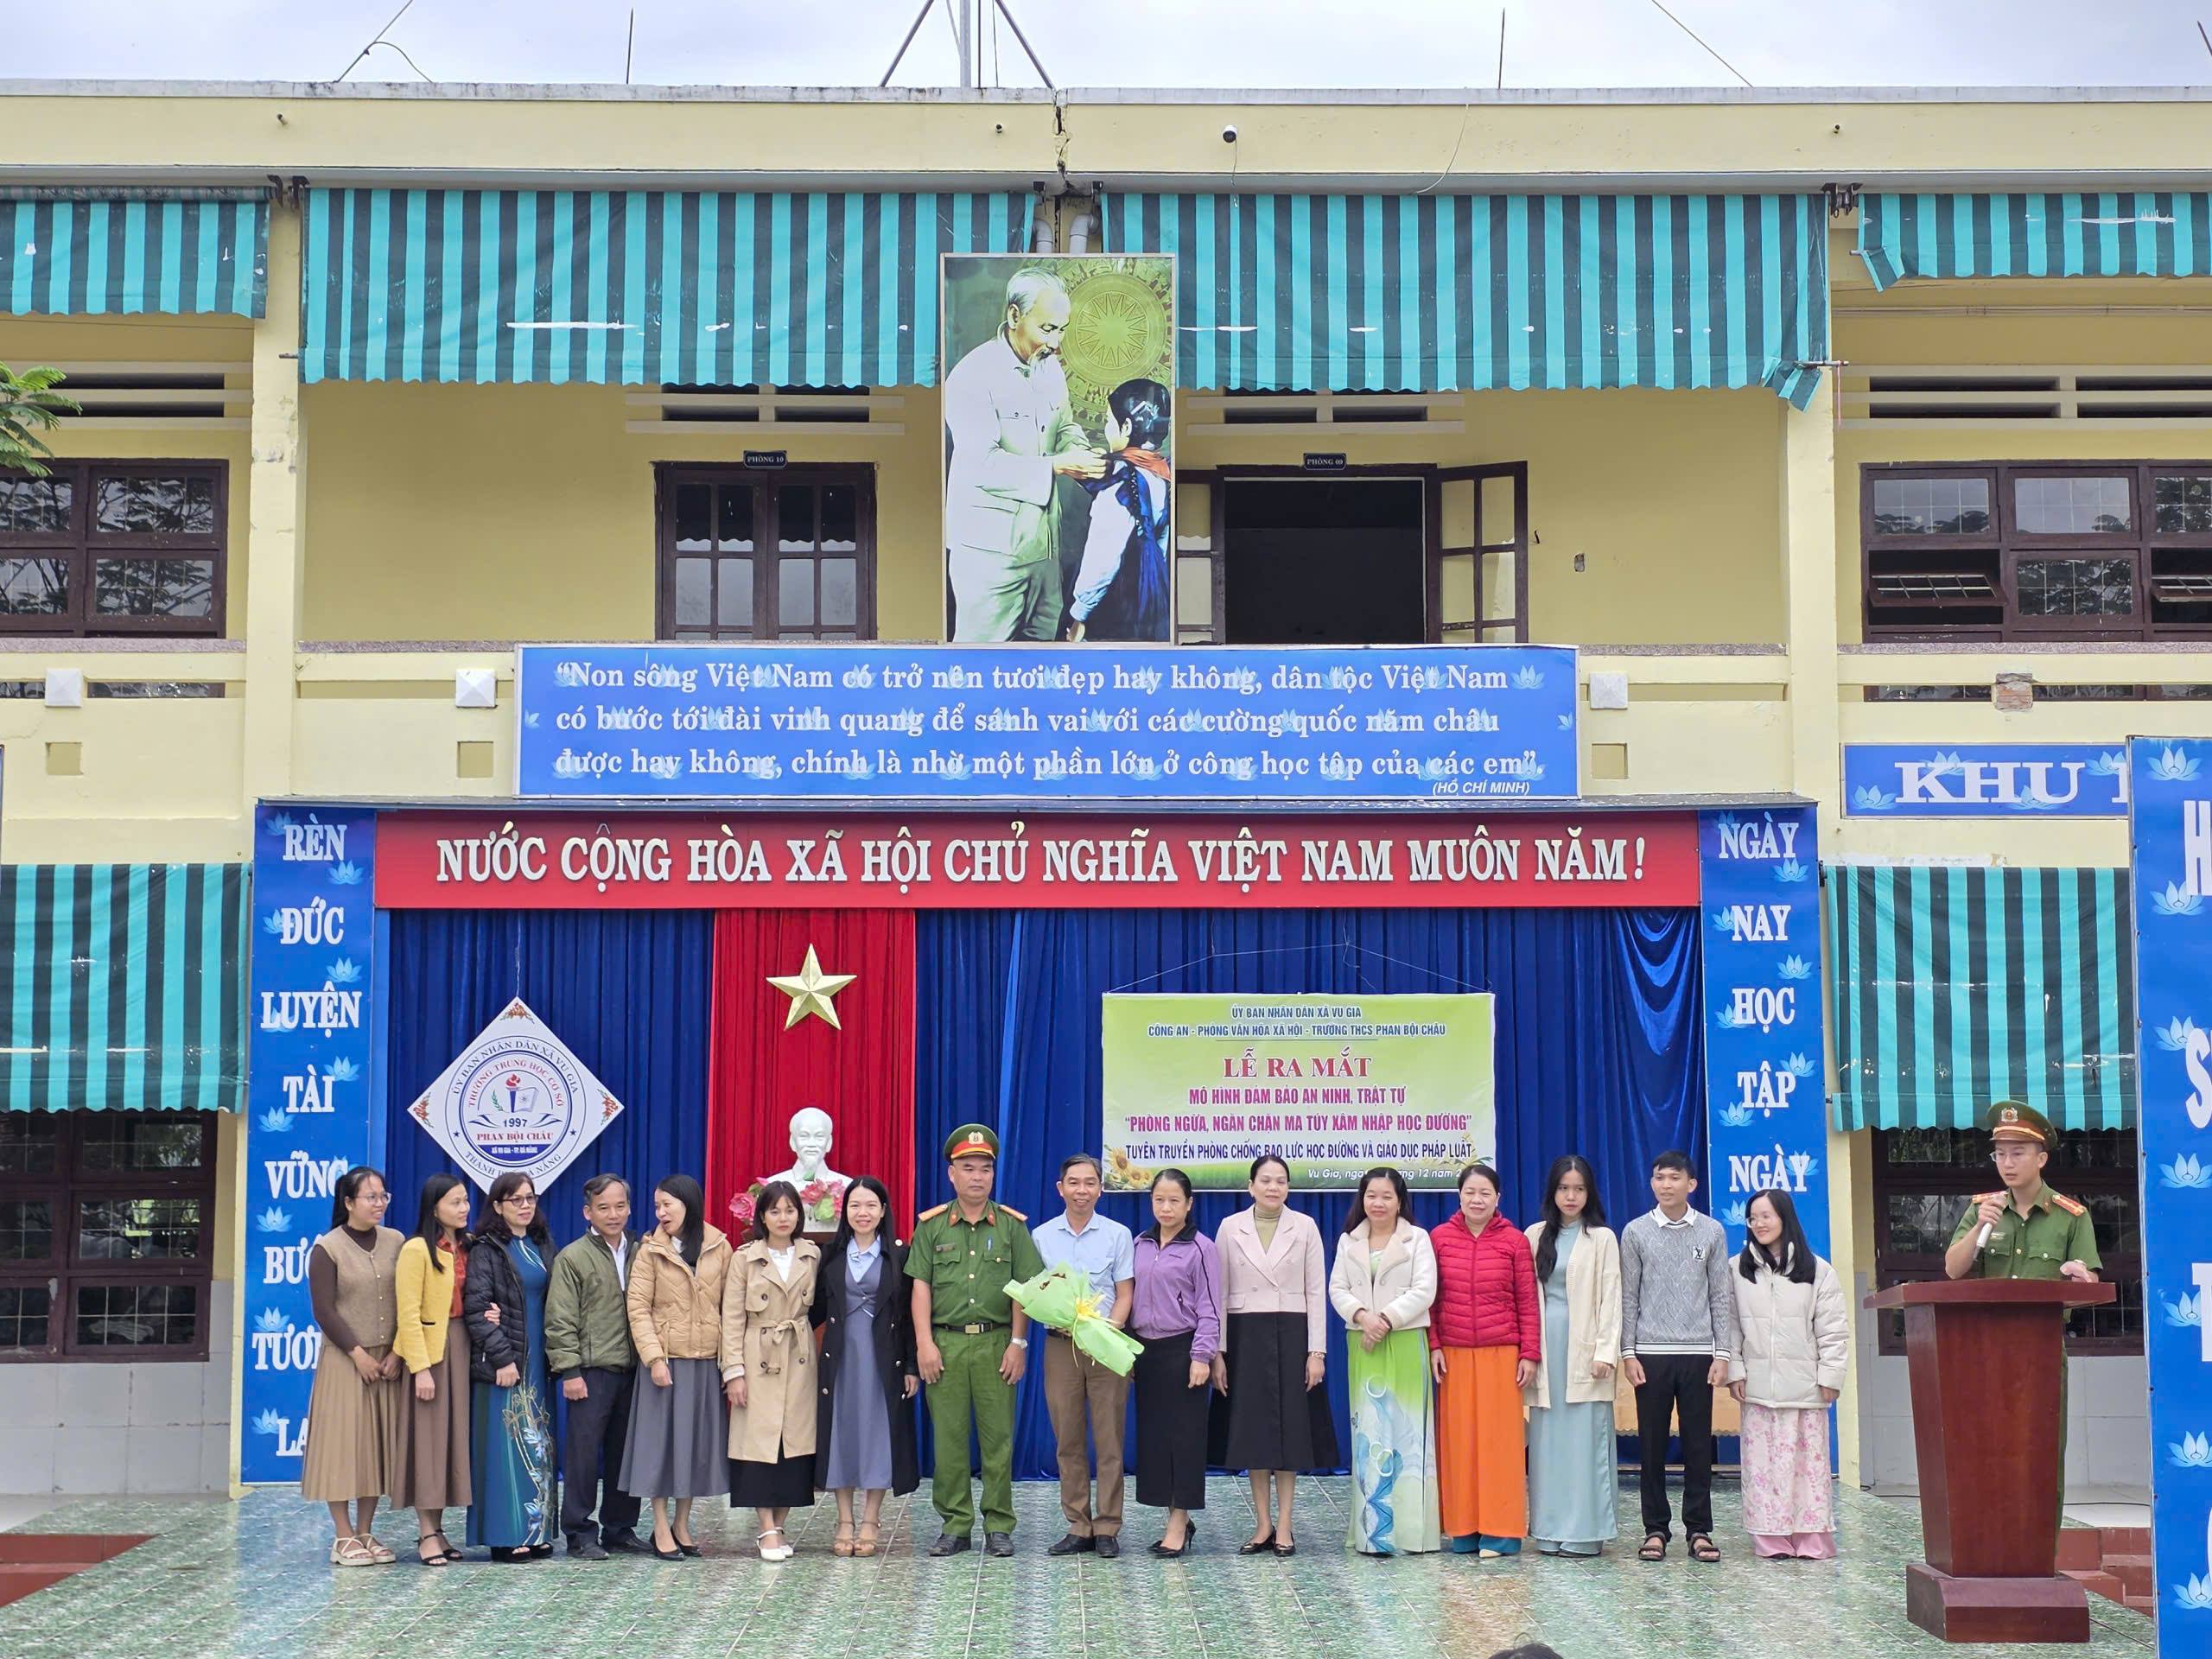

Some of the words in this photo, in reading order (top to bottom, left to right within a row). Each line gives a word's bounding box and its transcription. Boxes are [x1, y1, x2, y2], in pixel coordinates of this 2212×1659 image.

[747, 454, 774, 463] PHÒNG
[1306, 456, 1334, 466] PHÒNG
[633, 664, 697, 692] sông
[706, 663, 763, 688] Việt
[772, 664, 832, 688] Nam
[842, 663, 872, 689] có
[882, 663, 923, 689] trở
[932, 664, 983, 689] nên
[992, 664, 1046, 690] tươi
[1055, 664, 1103, 694] đẹp
[1113, 664, 1161, 693] hay
[1170, 664, 1262, 694] không,
[1271, 664, 1321, 690] dân
[1329, 665, 1372, 693] tộc
[1382, 664, 1438, 693] Việt
[1446, 664, 1507, 689] Nam
[556, 705, 586, 730] có
[597, 705, 663, 731] bước
[672, 706, 709, 731] tới
[718, 706, 760, 731] đài
[771, 706, 830, 731] vinh
[840, 709, 924, 737] quang
[932, 702, 965, 731] để
[975, 706, 1039, 732] sánh
[1048, 707, 1089, 732] vai
[1098, 706, 1139, 732] với
[1147, 707, 1189, 733] các
[1200, 707, 1283, 738] cường
[1293, 702, 1357, 738] quốc
[1365, 709, 1425, 733] năm
[1433, 707, 1500, 733] châu
[556, 748, 621, 779] được
[632, 748, 680, 779] hay
[690, 748, 782, 779] không,
[791, 748, 868, 775] chính
[877, 749, 902, 774] là
[912, 748, 964, 775] nhờ
[973, 750, 1025, 779] một
[1033, 747, 1103, 781] phần
[1111, 750, 1154, 776] lớn
[1163, 749, 1180, 775] ở
[1188, 751, 1254, 781] công
[1261, 750, 1309, 780] học
[1319, 751, 1363, 781] tập
[1371, 749, 1420, 777] của
[1428, 751, 1474, 777] các
[1432, 779, 1459, 796] (HỒ
[1461, 779, 1490, 794] CHÍ
[1491, 780, 1530, 796] MINH)
[1895, 762, 2085, 804] KHU
[283, 812, 346, 861] RÈN
[1719, 811, 1799, 859] NGÀY
[436, 820, 547, 882] NƯỚC
[560, 823, 671, 893] CỘNG
[687, 823, 772, 882] HÒA
[785, 829, 848, 882] XÃ
[861, 826, 932, 894] HỘI
[944, 821, 1030, 882] CHỦ
[1042, 828, 1179, 882] NGHĨA
[1188, 826, 1287, 893] VIỆT
[1300, 839, 1394, 882] NAM
[1406, 824, 1521, 881] MUÔN
[280, 895, 345, 944] ĐỨC
[1732, 905, 1791, 941] NAY
[260, 980, 362, 1038] LUYỆN
[1732, 987, 1796, 1034] HỌC
[1223, 1047, 1258, 1077] LỄ
[1267, 1058, 1304, 1077] RA
[1312, 1046, 1372, 1077] MẮT
[283, 1064, 335, 1112] TÀI
[1189, 1086, 1208, 1104] MÔ
[1211, 1086, 1241, 1104] HÌNH
[1244, 1086, 1271, 1104] ĐẢM
[1274, 1086, 1299, 1104] BẢO
[1302, 1089, 1318, 1104] AN
[1322, 1088, 1353, 1105] NINH,
[1357, 1085, 1387, 1106] TRẬT
[1390, 1086, 1407, 1107] TỰ
[1737, 1060, 1796, 1117] TẬP
[503, 1118, 527, 1128] 1997
[1126, 1141, 1156, 1160] TUYÊN
[1159, 1139, 1194, 1160] TRUYỀN
[1198, 1141, 1228, 1159] PHÒNG
[1286, 1141, 1304, 1162] LỰC
[1306, 1143, 1325, 1161] HỌC
[1328, 1140, 1359, 1159] ĐƯỜNG
[1362, 1140, 1374, 1159] VÀ
[1376, 1140, 1398, 1159] GIÁO
[1401, 1142, 1419, 1160] DỤC
[1421, 1140, 1446, 1159] PHÁP
[1449, 1139, 1472, 1160] LUẬT
[1729, 1144, 1810, 1192] NGÀY
